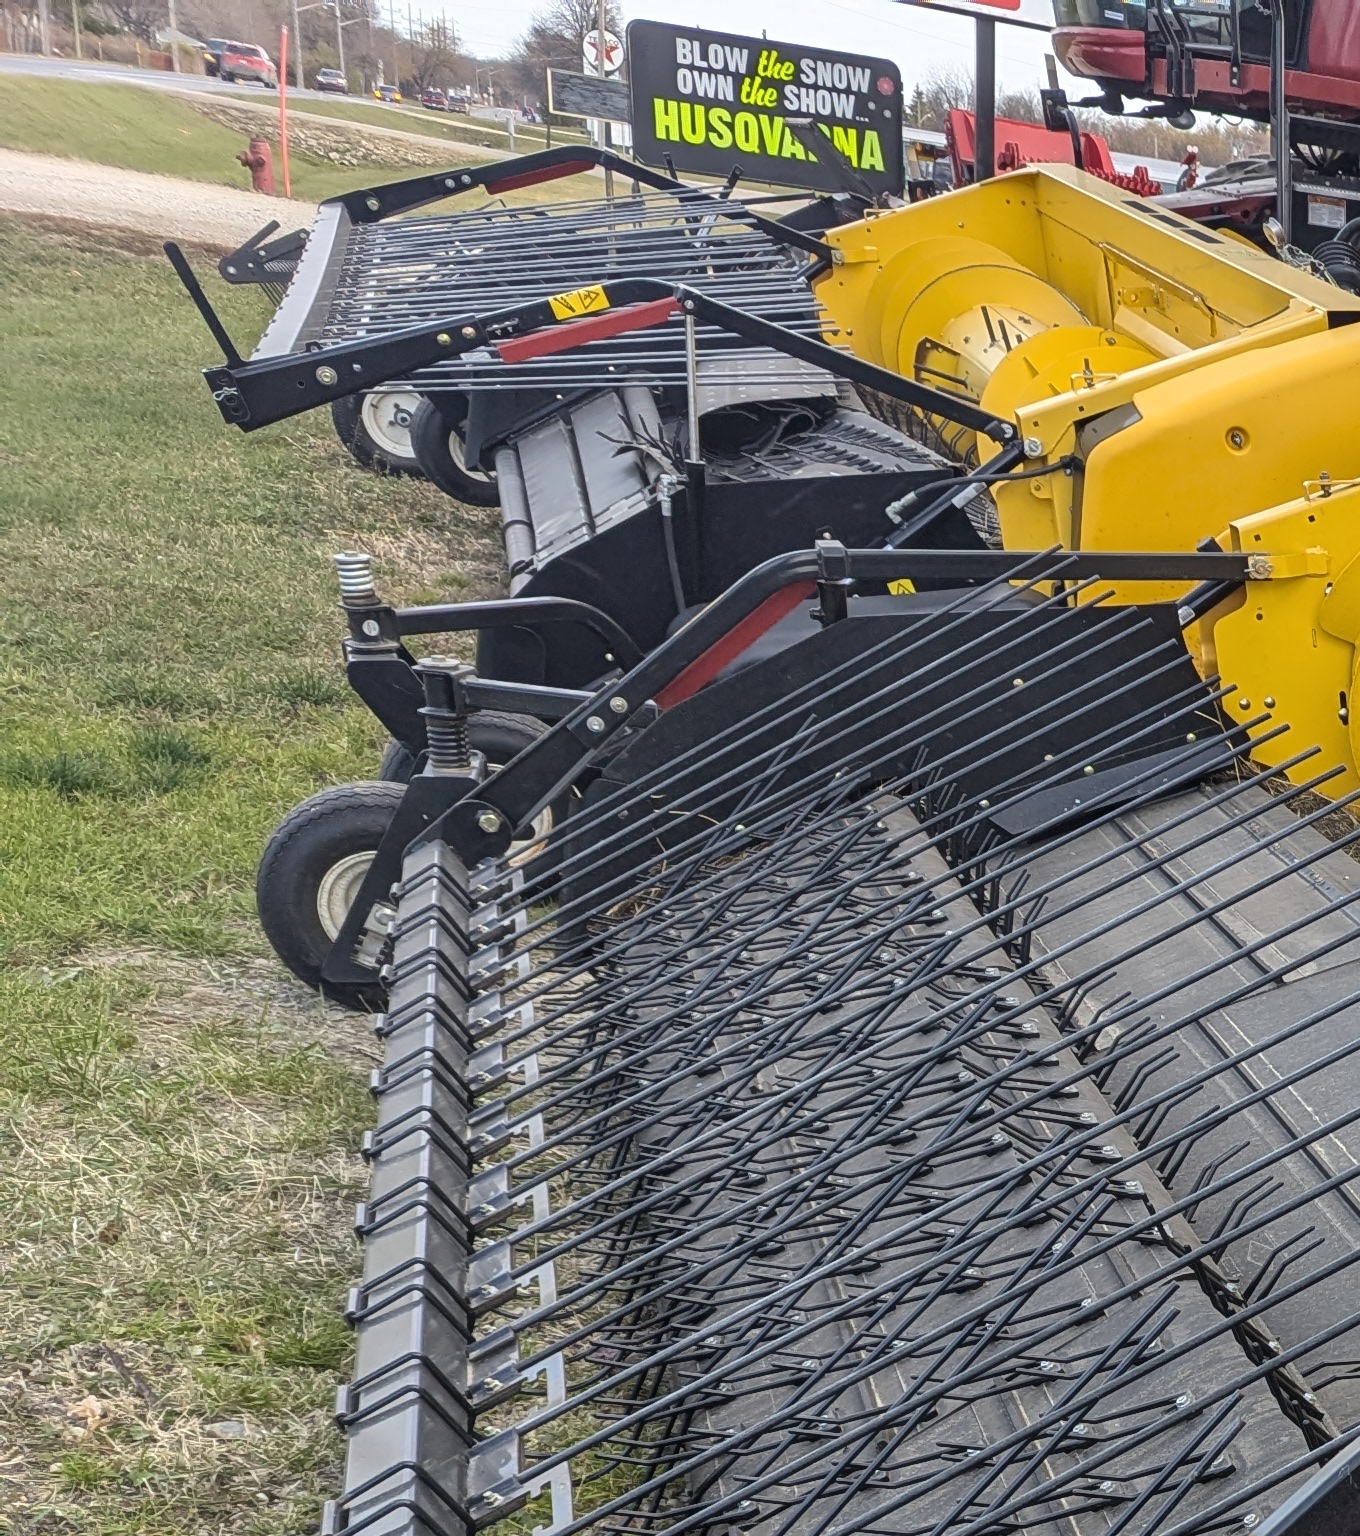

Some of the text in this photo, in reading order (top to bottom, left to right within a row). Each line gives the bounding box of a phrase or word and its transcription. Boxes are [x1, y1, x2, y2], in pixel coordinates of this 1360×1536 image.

[675, 37, 871, 93] BLOW the SNOW
[676, 68, 734, 101] OWN
[740, 76, 778, 107] the
